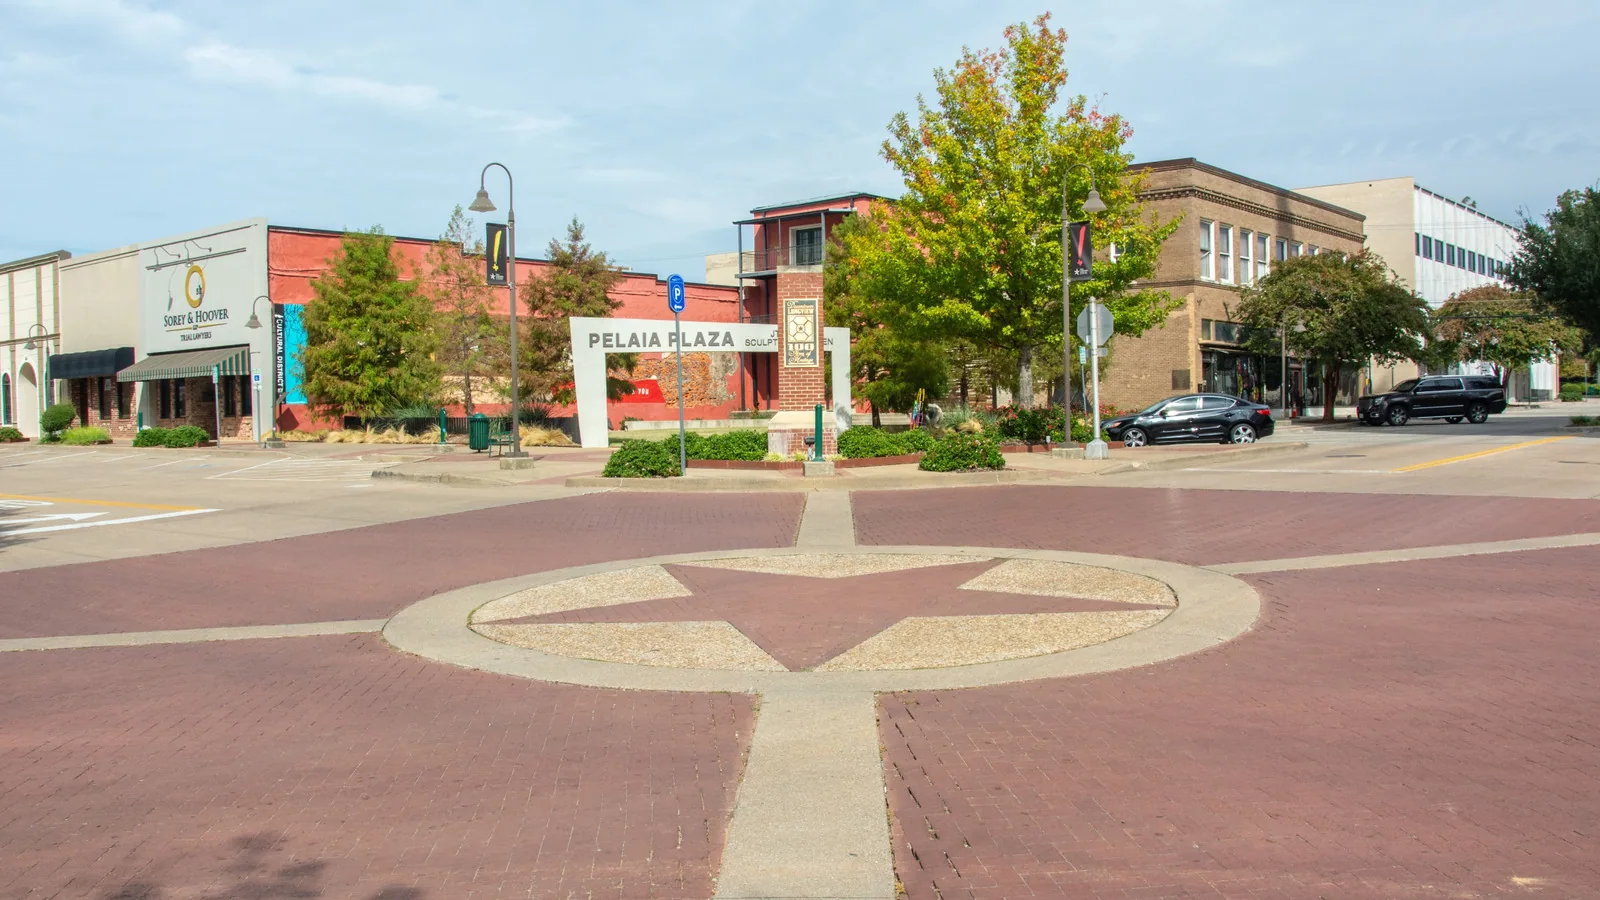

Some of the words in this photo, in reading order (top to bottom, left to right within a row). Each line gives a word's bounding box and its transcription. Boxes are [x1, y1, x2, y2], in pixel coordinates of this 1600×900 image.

[674, 287, 681, 300] P
[163, 314, 186, 327] SOREY
[187, 311, 194, 324] &
[196, 309, 229, 322] HOOVER
[180, 333, 193, 342] TRIAL
[192, 331, 212, 340] LAWYERS
[589, 332, 662, 348] PELAIA
[668, 331, 735, 347] PLAZA
